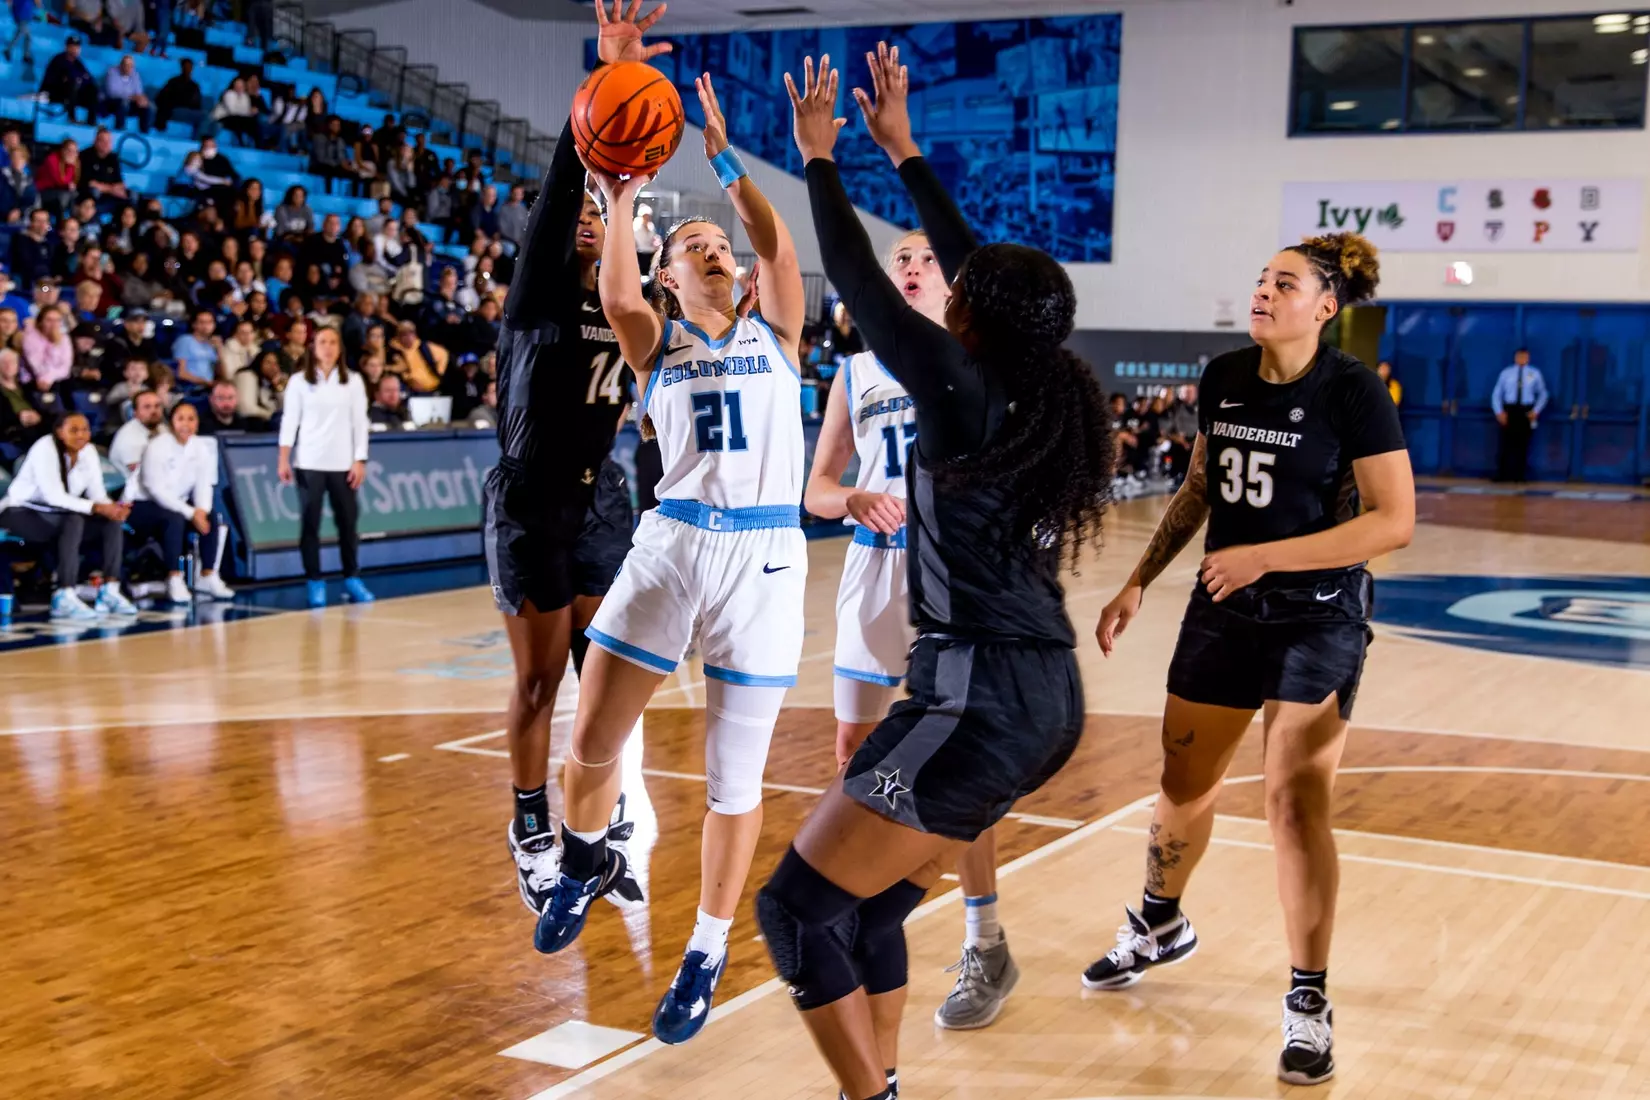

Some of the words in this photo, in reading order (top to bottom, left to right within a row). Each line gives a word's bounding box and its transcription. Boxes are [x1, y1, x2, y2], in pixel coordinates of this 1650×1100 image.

[1316, 199, 1373, 234] Ivy
[1579, 220, 1599, 242] Y
[1533, 221, 1550, 243] P
[585, 351, 625, 405] 14
[661, 355, 772, 387] COLUMBIA
[690, 389, 749, 454] 21
[1212, 421, 1302, 448] VANDERBILT
[1219, 447, 1276, 508] 35
[708, 511, 723, 530] C
[883, 779, 896, 795] V
